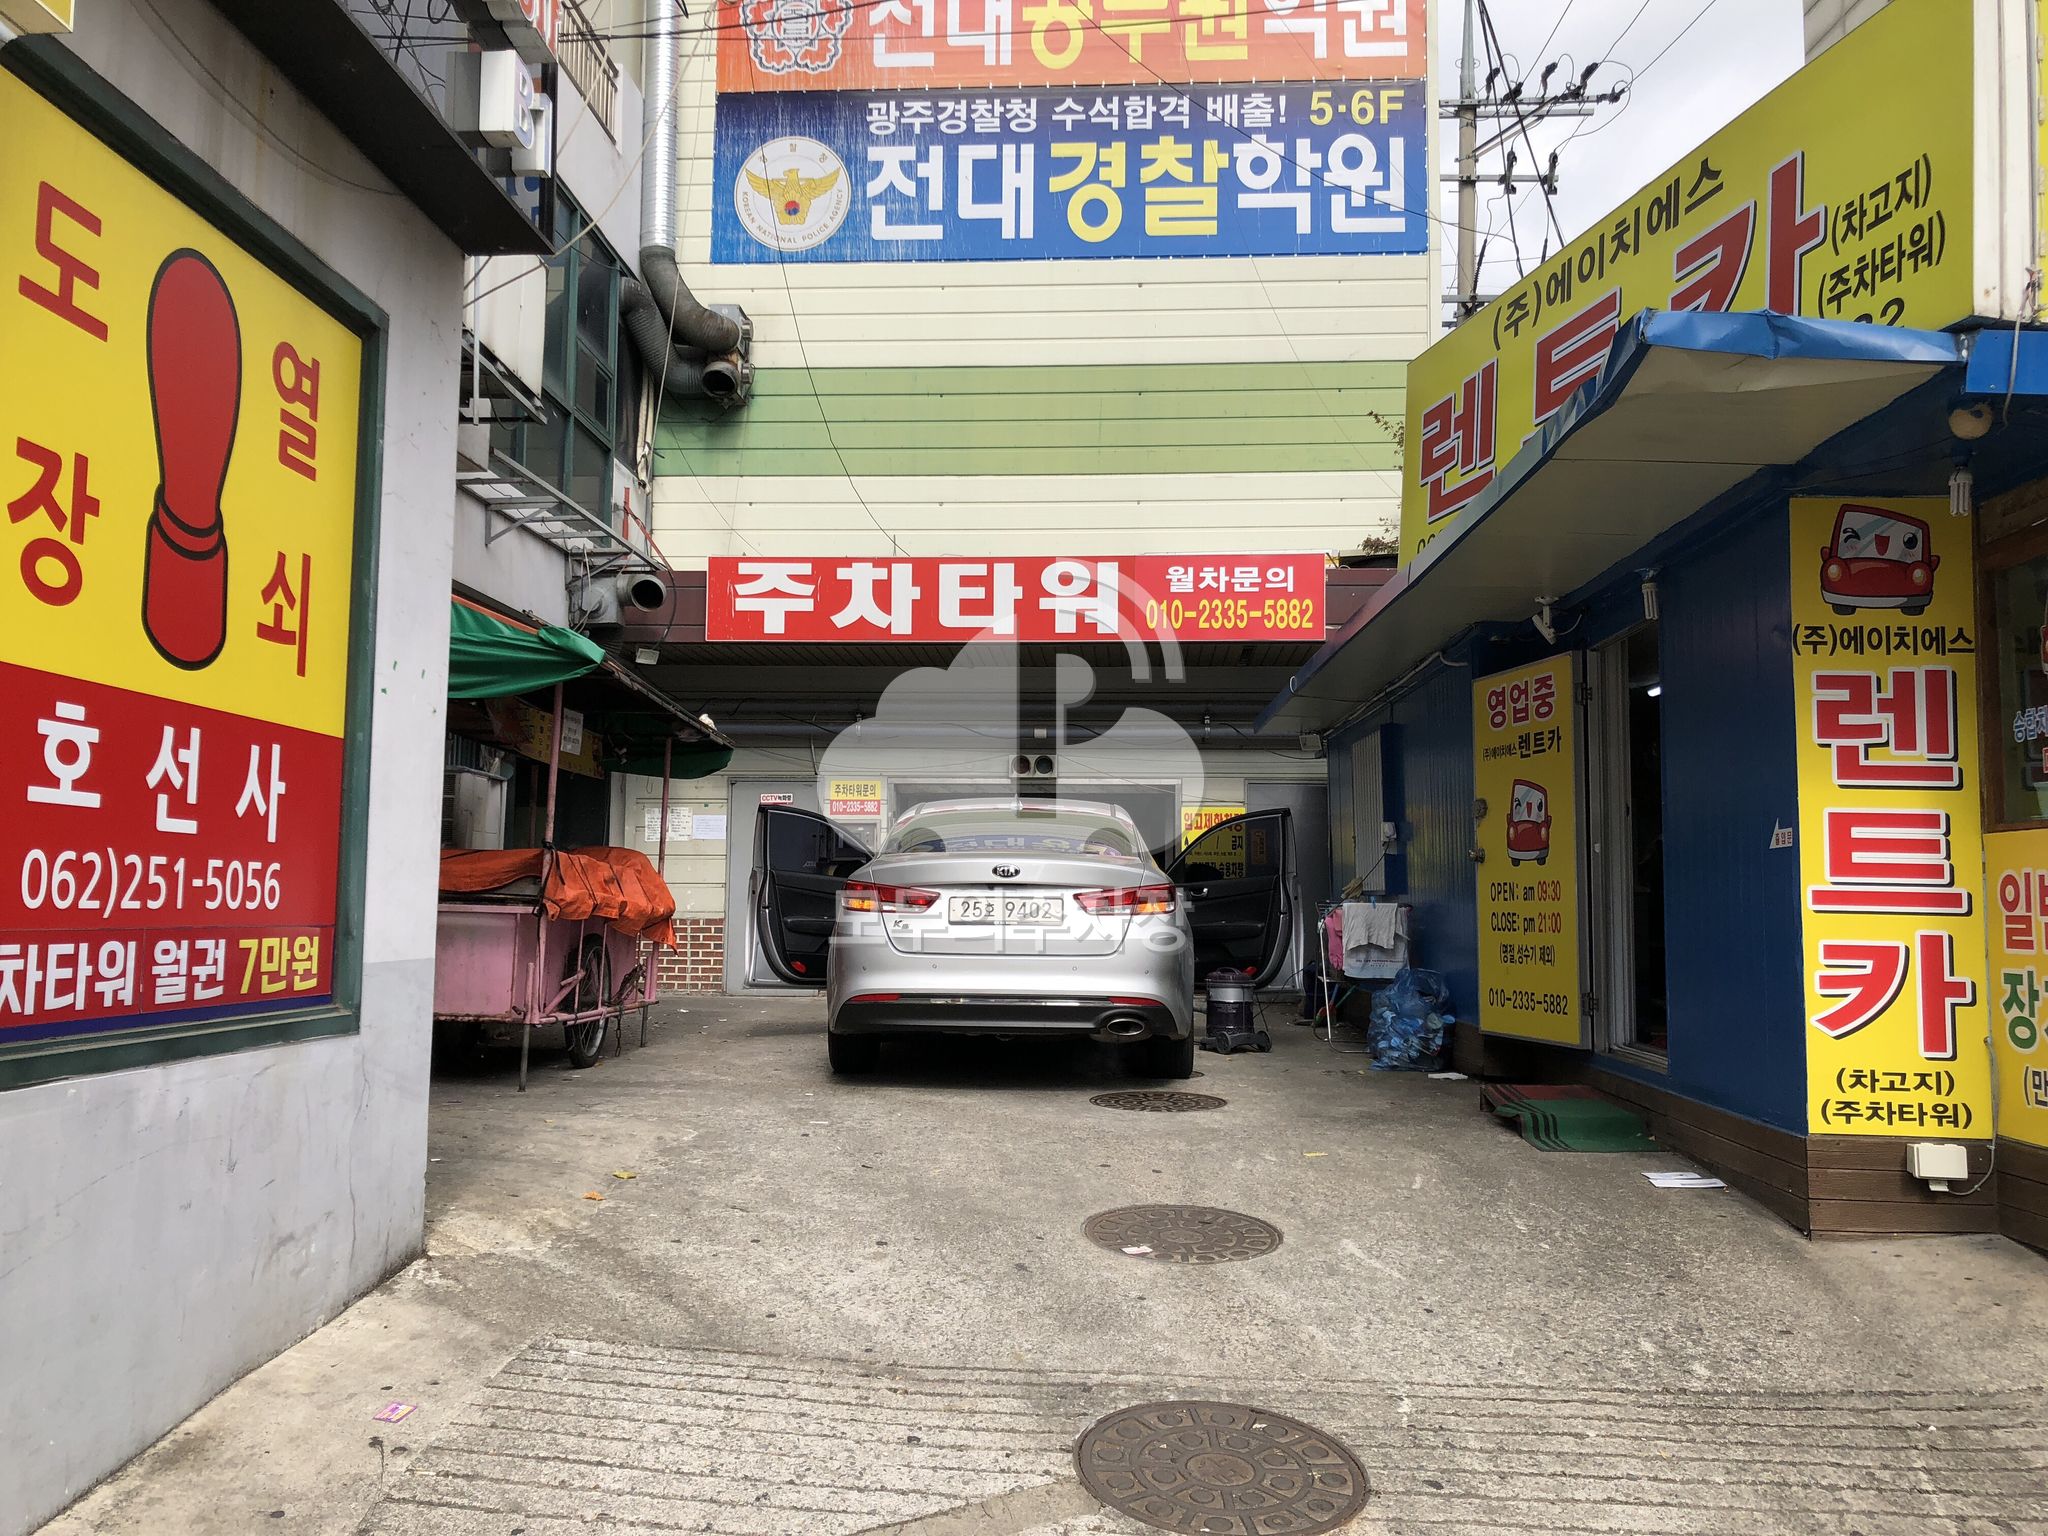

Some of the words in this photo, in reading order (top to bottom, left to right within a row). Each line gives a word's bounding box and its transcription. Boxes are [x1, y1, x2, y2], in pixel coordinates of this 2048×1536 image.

[866, 97, 1037, 135] 광주경찰청
[1052, 95, 1191, 132] 수석합격
[1205, 93, 1286, 129] 배출!
[866, 133, 1406, 243] 전대경찰학원
[1831, 152, 1932, 257] (차고지)
[742, 190, 756, 225] KOREAN
[756, 224, 798, 244] NATIONAL
[801, 224, 829, 242] POLICE
[830, 188, 844, 223] AGENCY
[1493, 157, 1724, 351] (주)에이치에스
[1817, 209, 1946, 320] (주차타워)
[734, 562, 1119, 635] 주차타워
[1166, 565, 1296, 593] 월차문의
[1145, 598, 1313, 630] 010-2335-5882
[1792, 623, 1975, 656] (주)에이치에스
[1487, 674, 1556, 729] 영업중
[1518, 725, 1562, 759] 렌트카
[21, 847, 281, 918] 062)251-5056
[1806, 665, 1977, 1061] 렌트카
[1522, 886, 1535, 901] am
[1537, 880, 1561, 902] 09:30
[1490, 911, 1520, 932] CLOSE:
[1523, 916, 1536, 935] pm
[1538, 912, 1562, 933] 21:00
[152, 937, 225, 1005] 월권
[239, 935, 319, 995] 7만원
[1488, 987, 1569, 1016] 010-2335-5882
[1835, 1066, 1955, 1097] (차고지)
[1820, 1098, 1973, 1130] (주차타워)
